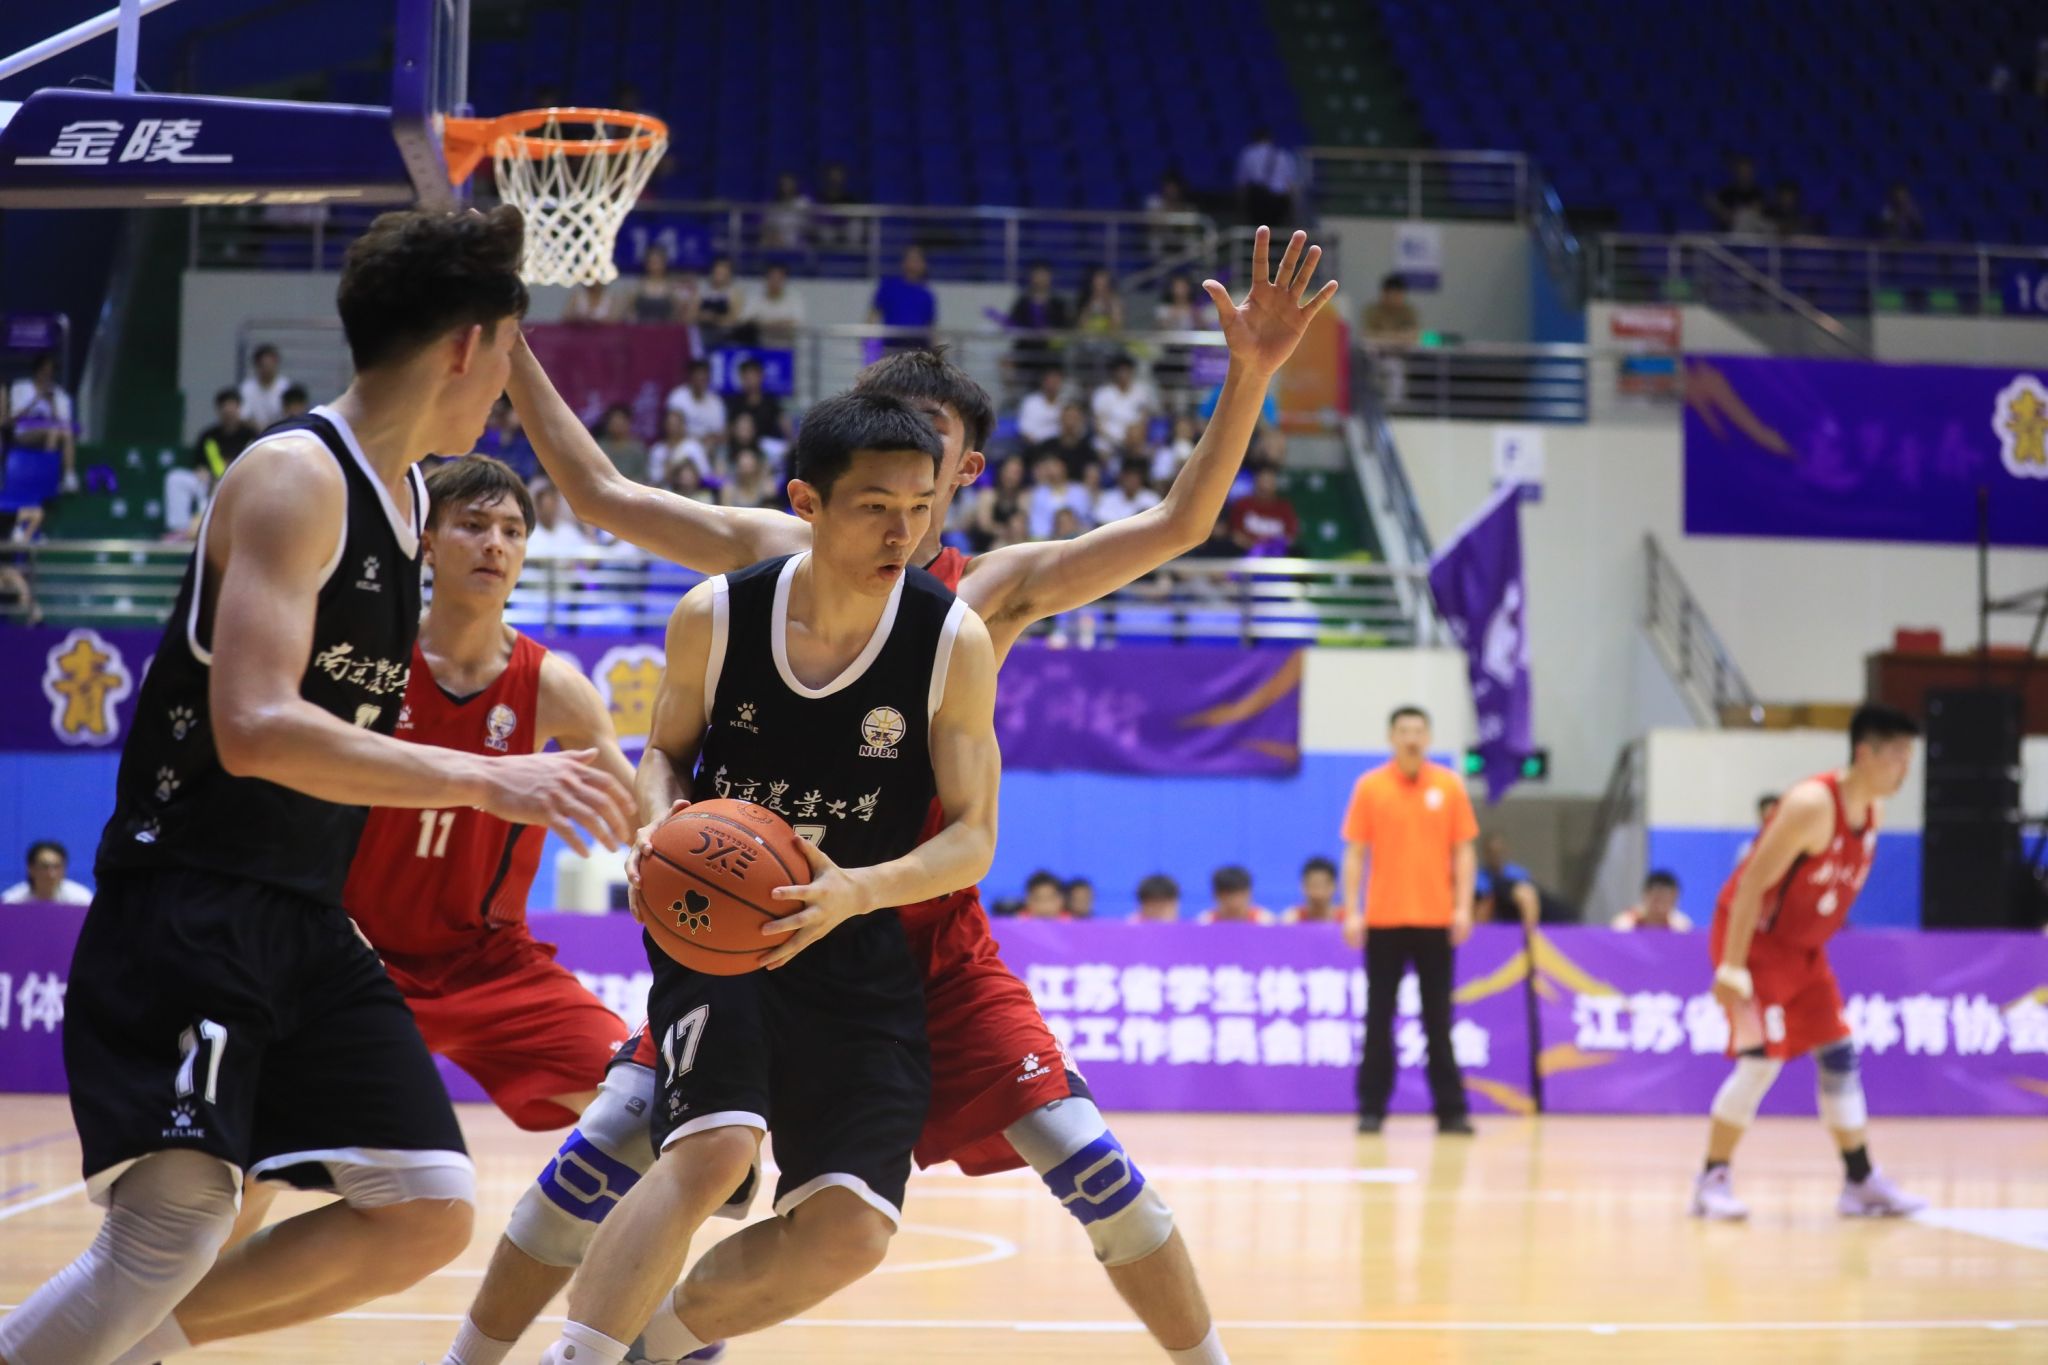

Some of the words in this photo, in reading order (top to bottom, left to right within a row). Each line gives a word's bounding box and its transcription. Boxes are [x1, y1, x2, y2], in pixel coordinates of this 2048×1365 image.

[14, 119, 233, 165] 金陵
[858, 745, 898, 759] NUBA
[416, 809, 456, 859] 11
[661, 1004, 709, 1088] 17
[1017, 1066, 1051, 1083] KELME
[162, 1128, 205, 1138] KELME
